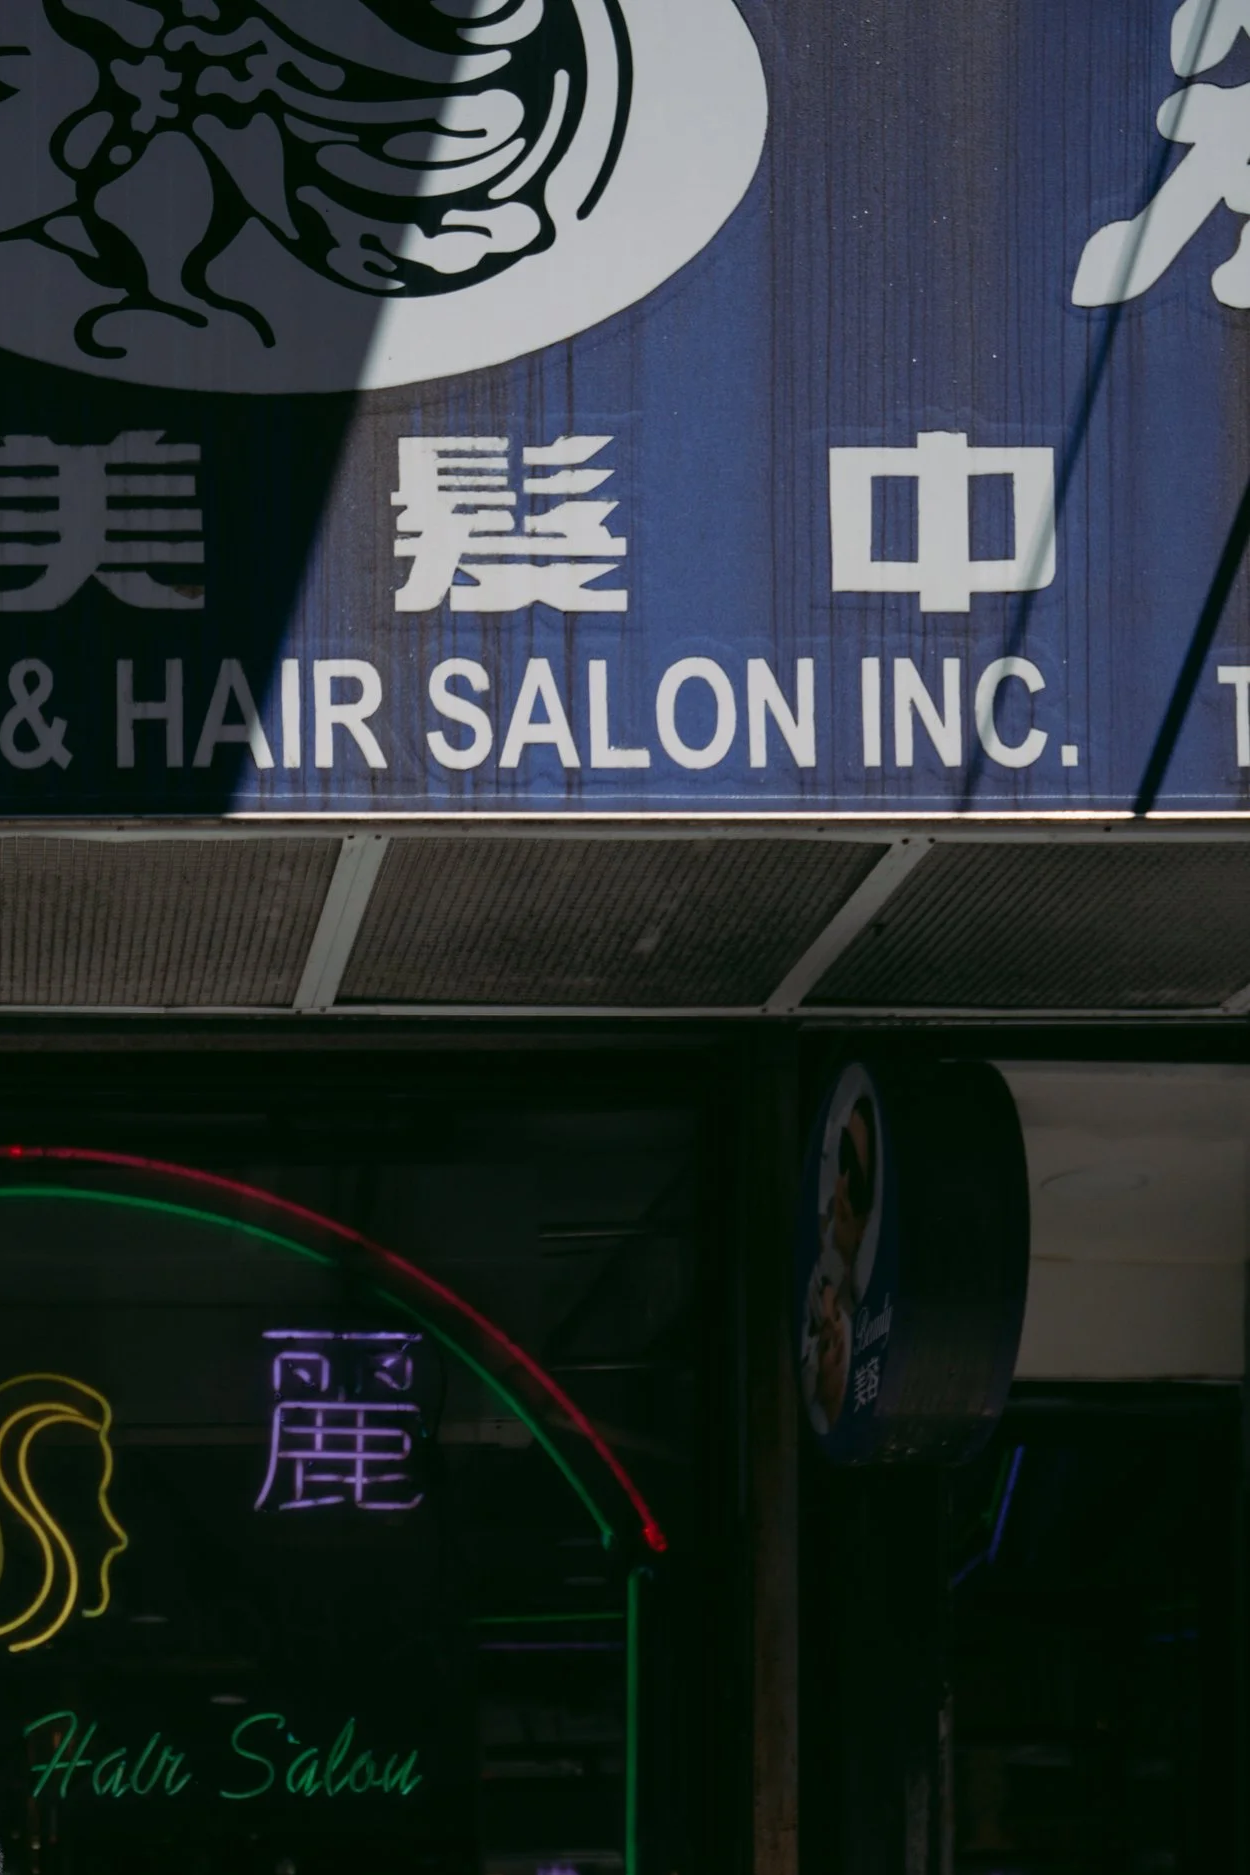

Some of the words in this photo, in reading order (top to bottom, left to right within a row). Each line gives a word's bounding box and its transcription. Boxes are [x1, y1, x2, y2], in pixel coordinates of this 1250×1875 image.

[116, 657, 388, 771] HAIR
[425, 655, 817, 771] SALON
[861, 655, 1080, 771] INC.
[23, 1709, 193, 1799] Hair
[218, 1712, 425, 1800] Salon
